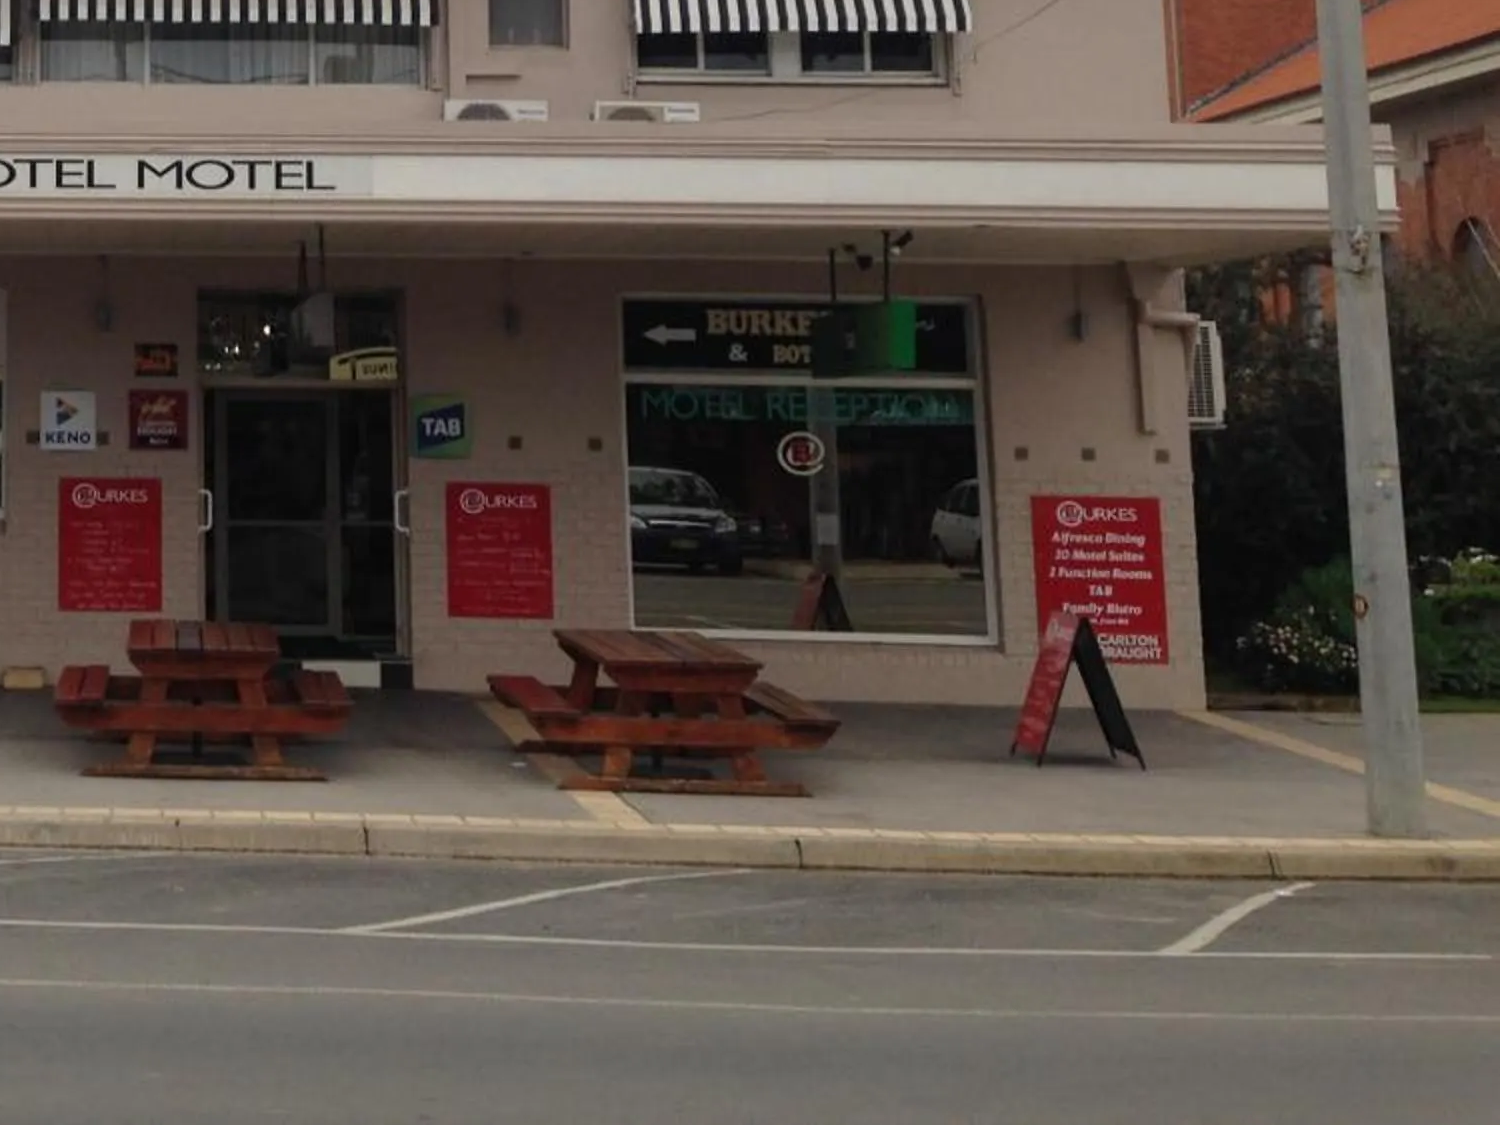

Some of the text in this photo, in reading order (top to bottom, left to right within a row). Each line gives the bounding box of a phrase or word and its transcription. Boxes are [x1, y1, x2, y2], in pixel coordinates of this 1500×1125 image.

[136, 159, 336, 191] MOTEL
[706, 309, 813, 336] BURKE
[729, 343, 748, 362] &
[421, 417, 461, 437] TAB
[45, 429, 91, 444] KENO
[1051, 532, 1146, 548] Alfresco Dining
[1058, 566, 1110, 580] Function
[1111, 568, 1153, 581] Rooms
[1088, 584, 1114, 597] TAB
[1062, 602, 1143, 616] Family Bistro
[1097, 633, 1159, 646] CARLTON
